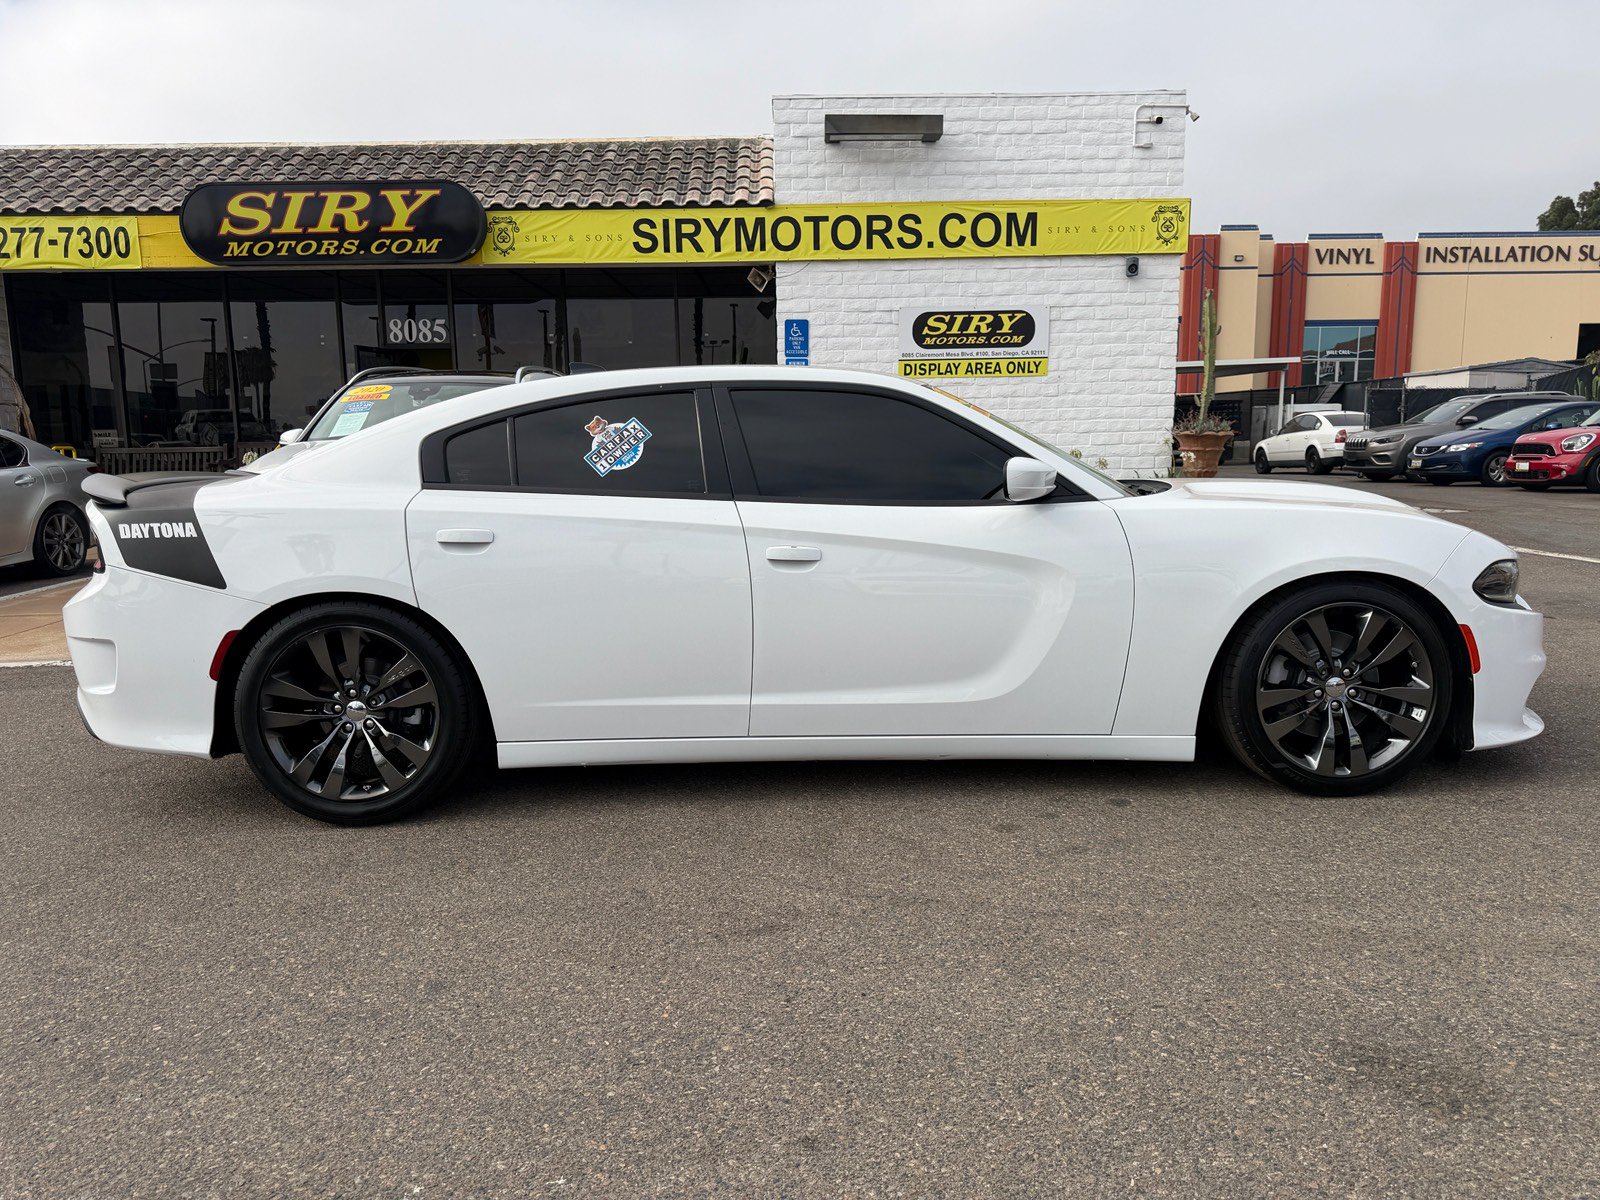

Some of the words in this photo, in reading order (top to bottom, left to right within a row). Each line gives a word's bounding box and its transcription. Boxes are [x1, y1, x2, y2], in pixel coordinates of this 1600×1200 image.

[217, 188, 442, 236] SIRY
[525, 234, 558, 242] SIRY
[569, 234, 575, 242] &
[586, 234, 623, 242] SONS
[632, 211, 1038, 254] SIRYMOTORS.COM
[1047, 226, 1081, 234] SIRY
[1091, 225, 1097, 233] &
[1108, 225, 1146, 233] SONS
[0, 226, 131, 259] 277-7300
[223, 238, 442, 257] MOTORS.COM
[1315, 247, 1375, 265] VINYL
[1425, 245, 1571, 264] INSTALLATION
[389, 318, 447, 343] 8085
[922, 313, 1026, 335] SIRY
[922, 335, 1025, 345] MOTORS.COM
[904, 362, 961, 377] DISPLAY
[965, 362, 1002, 375] AREA
[1006, 361, 1042, 374] ONLY
[591, 424, 639, 462] CARFAX
[599, 462, 607, 470] 1
[606, 431, 645, 464] OWNER
[118, 522, 198, 539] DAYTONA
